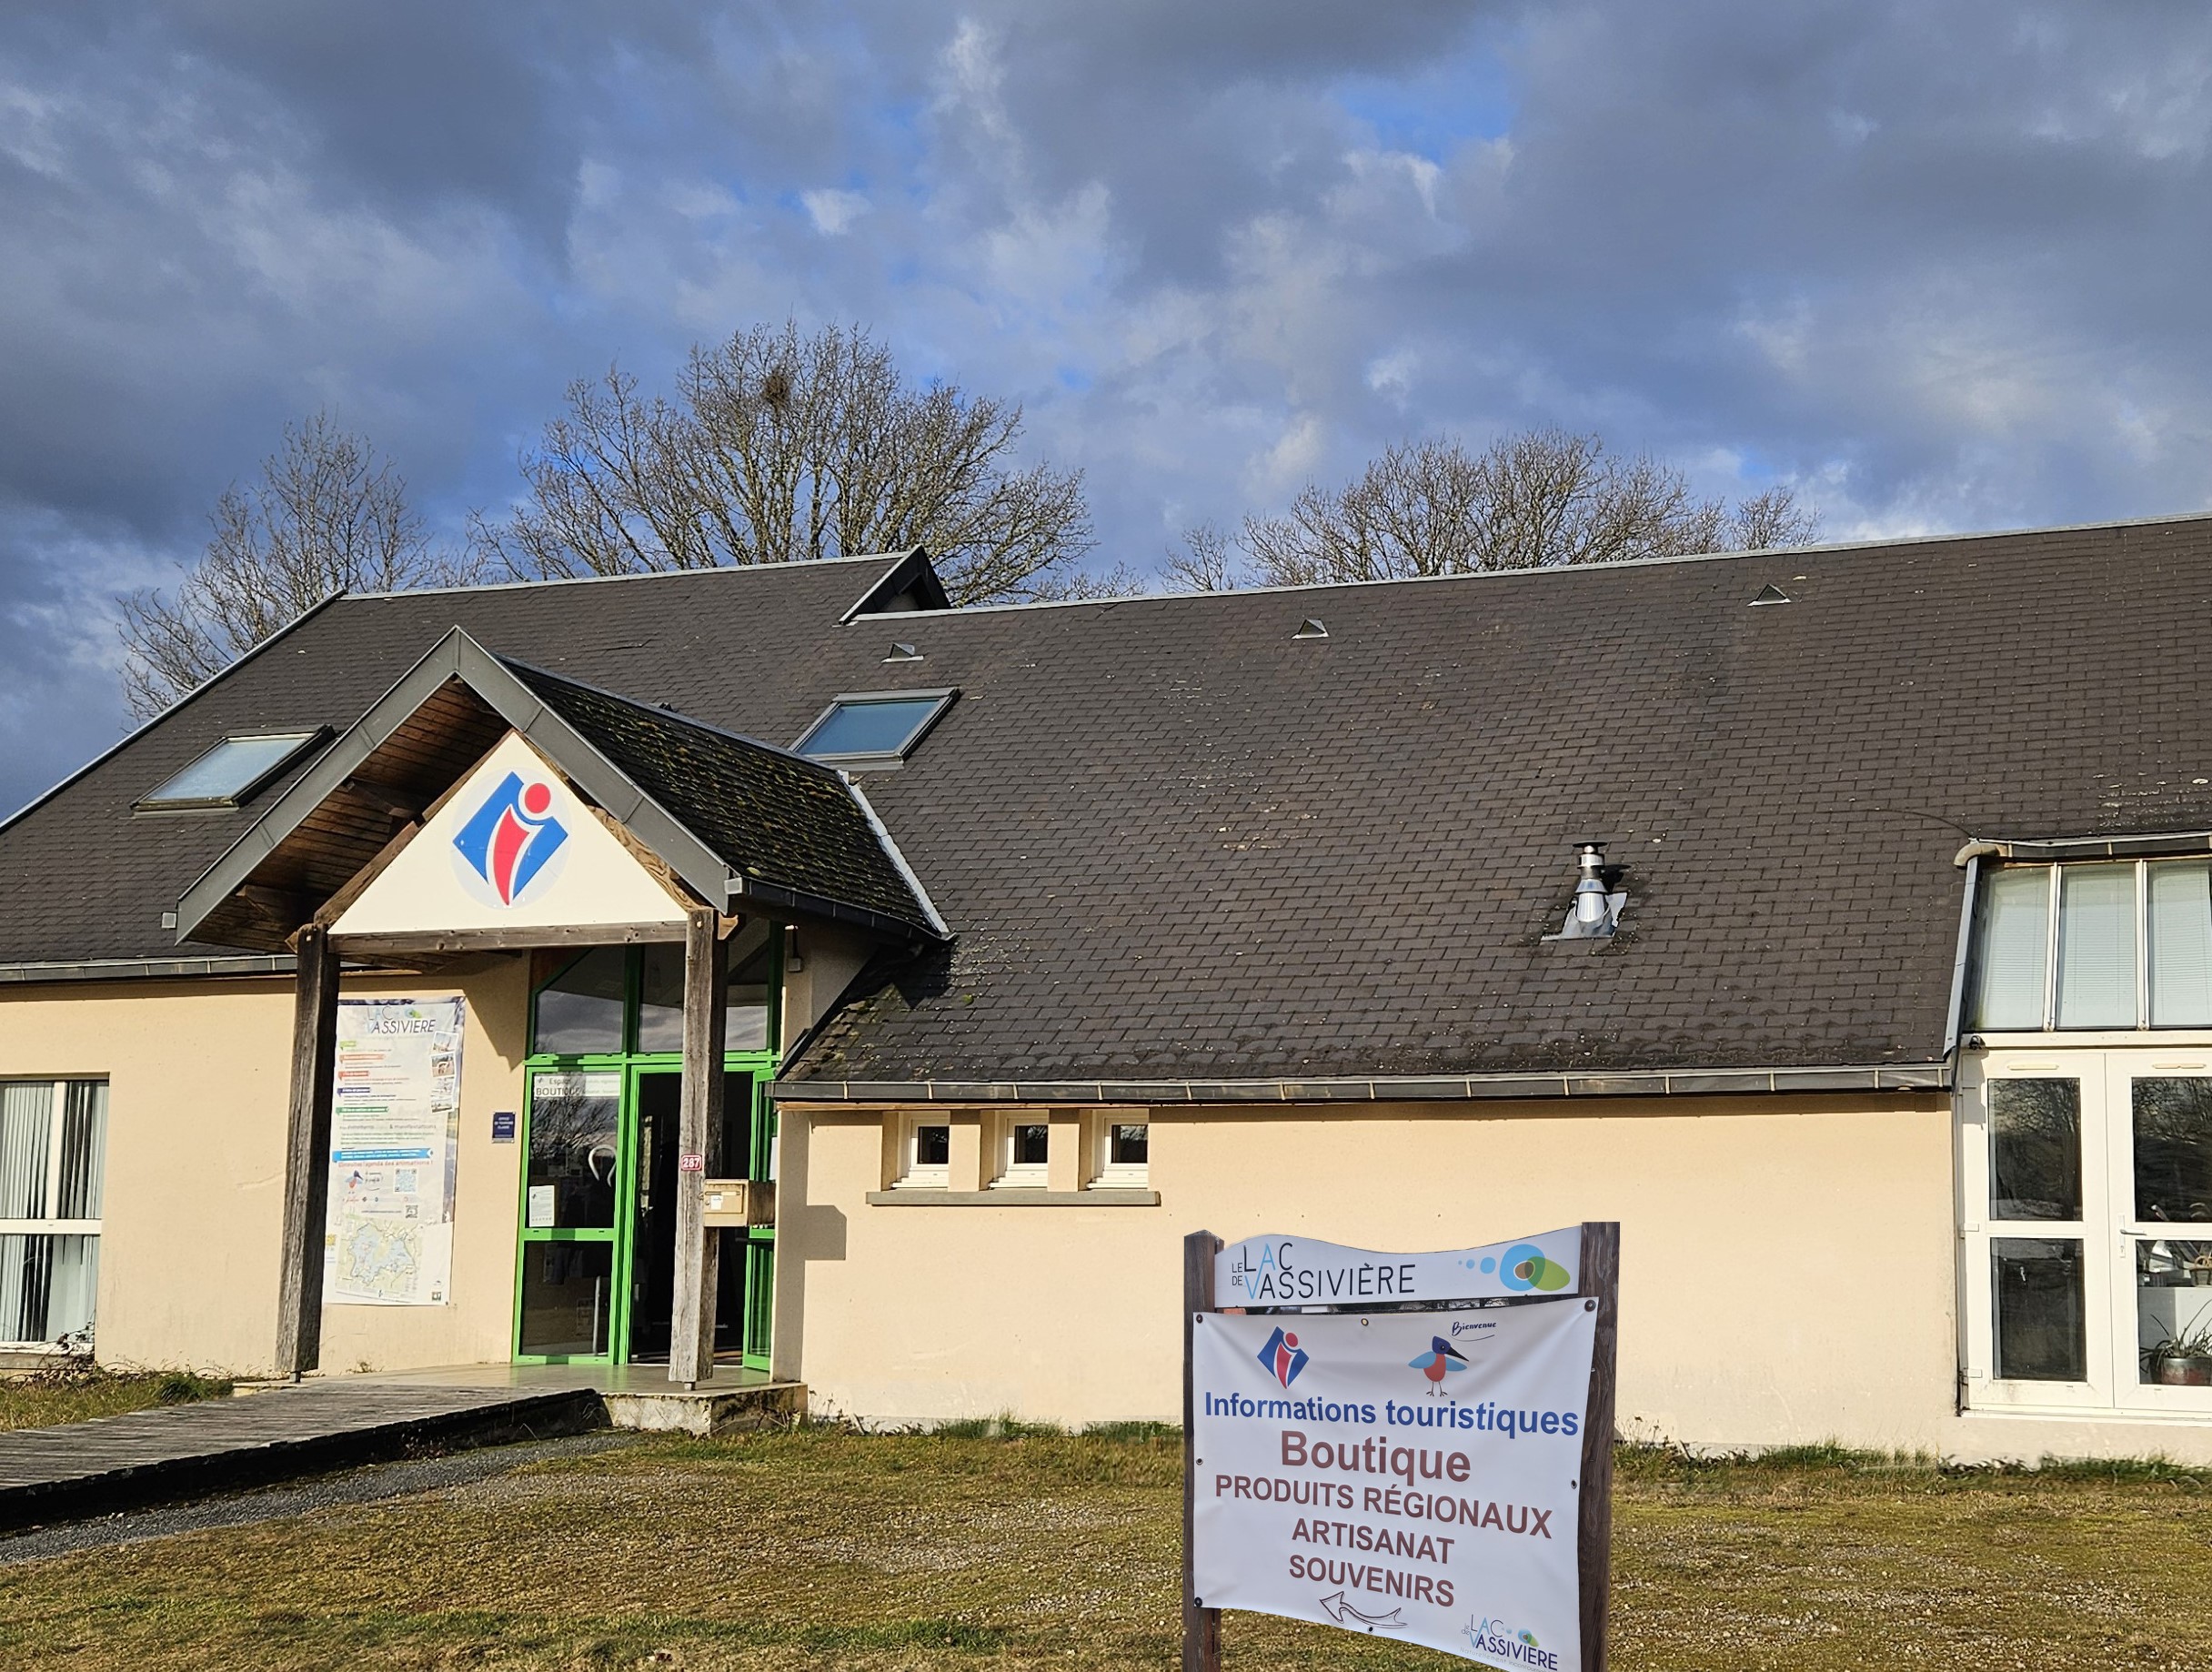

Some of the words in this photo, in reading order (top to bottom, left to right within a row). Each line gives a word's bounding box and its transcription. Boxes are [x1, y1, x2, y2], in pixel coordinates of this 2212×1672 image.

[367, 1006, 393, 1020] LAC
[682, 1157, 700, 1168] 287
[1232, 1263, 1243, 1274] LE
[1243, 1243, 1293, 1272] LAC
[1232, 1275, 1243, 1286] DE
[1244, 1263, 1416, 1299] VASSIVIÈRE
[1452, 1322, 1497, 1336] Bienvenue
[1205, 1392, 1376, 1424] Informations
[1386, 1399, 1579, 1439] touristiques
[1281, 1430, 1471, 1486] Boutique
[1215, 1475, 1354, 1509] PRODUITS
[1363, 1484, 1553, 1539] RÉGIONAUX
[1292, 1518, 1455, 1565] ARTISANAT
[1289, 1555, 1454, 1607] SOUVENIRS
[1471, 1614, 1503, 1637] LAC
[1509, 1659, 1550, 1672] incontourna
